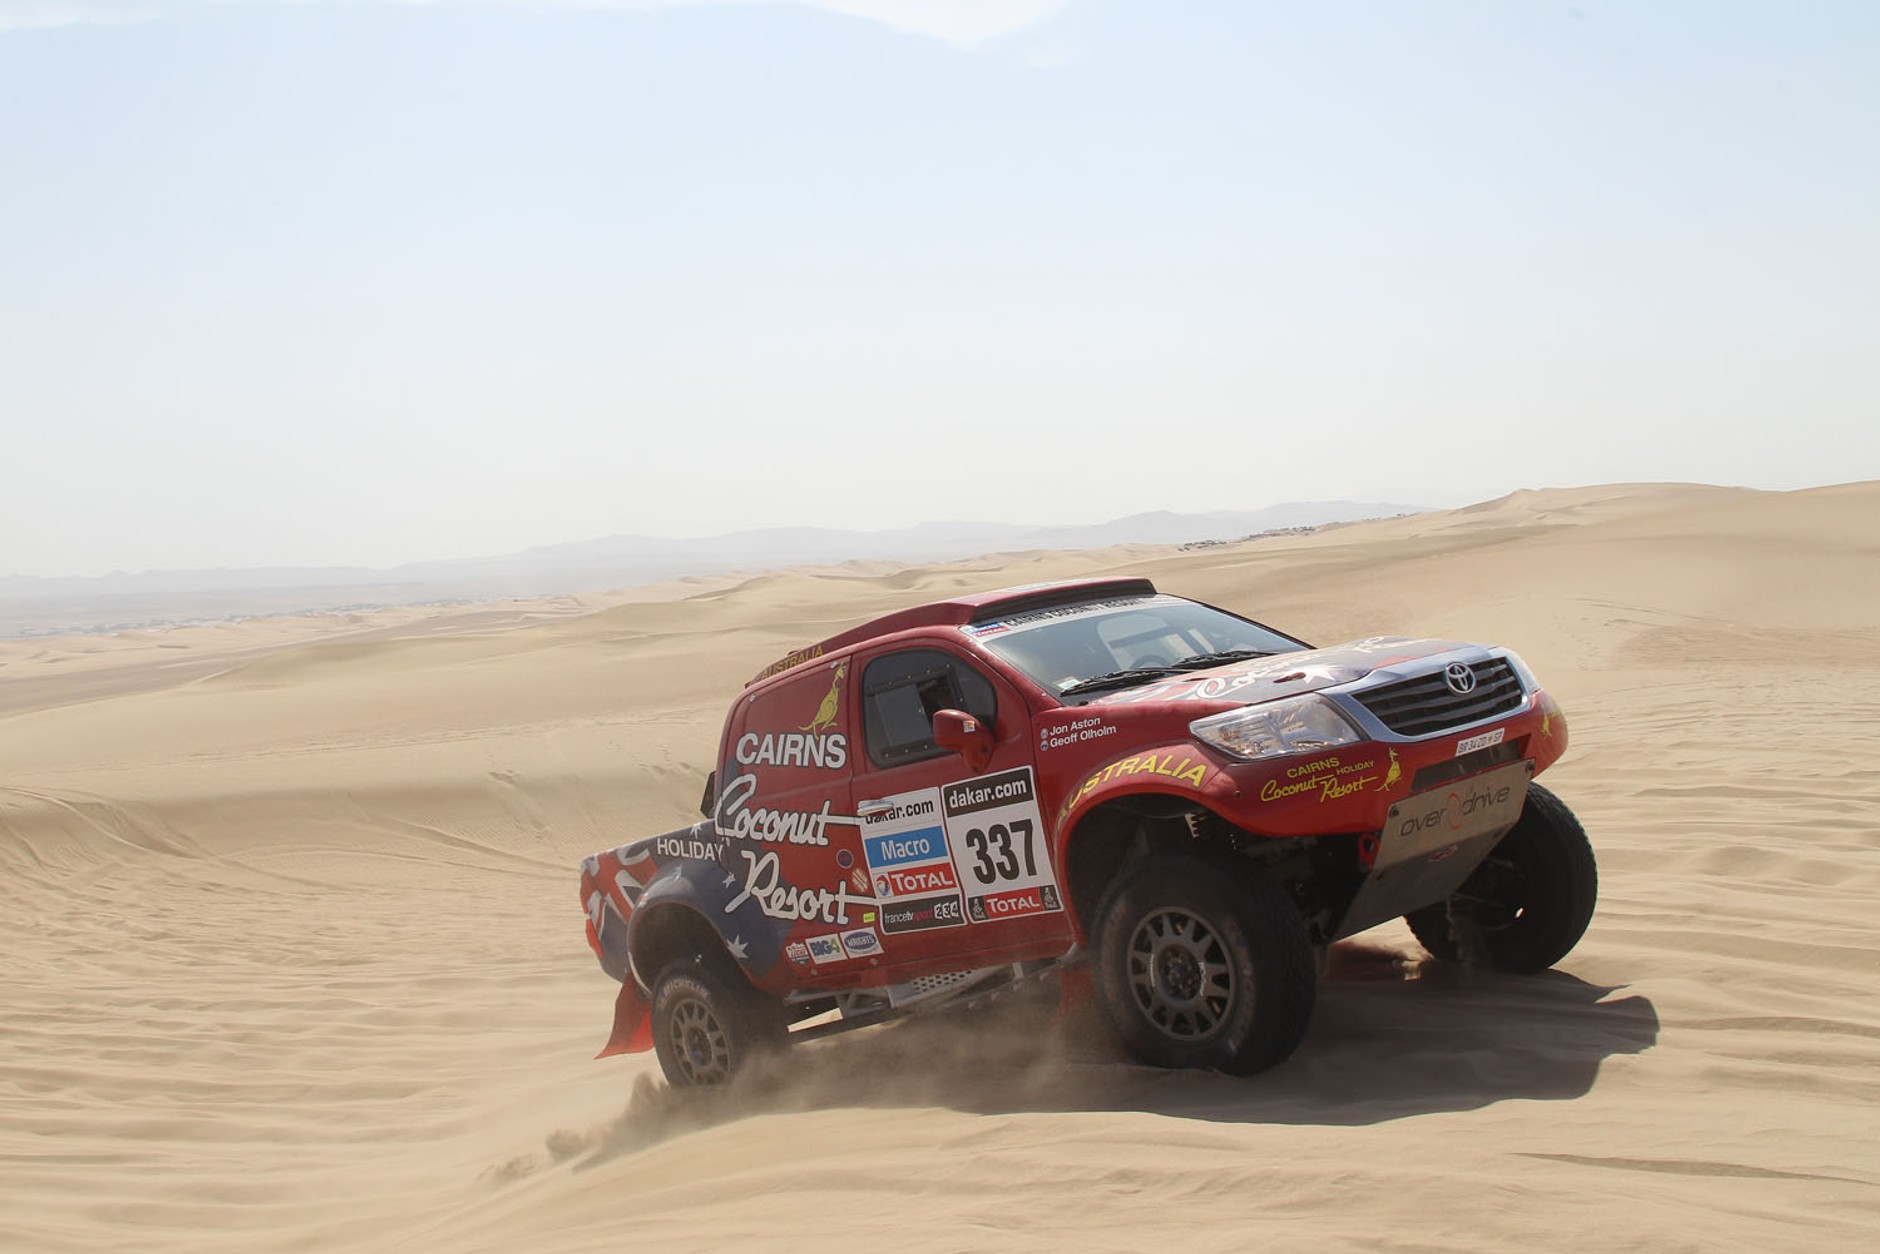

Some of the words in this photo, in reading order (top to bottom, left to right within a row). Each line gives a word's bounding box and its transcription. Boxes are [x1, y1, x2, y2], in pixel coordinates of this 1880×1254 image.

[1050, 725, 1068, 736] Jon
[1070, 717, 1101, 730] Aston
[1050, 733, 1078, 748] Geoff
[1080, 725, 1117, 741] Olholm
[736, 732, 847, 769] CAIRNS
[1286, 757, 1340, 778] CAIRNS
[1336, 760, 1374, 776] HOLIDAY
[949, 779, 1027, 809] dakar.com
[1261, 774, 1334, 801] Coconut
[1320, 775, 1379, 803] Resort
[714, 773, 866, 846] Coconut
[656, 837, 729, 862] HOLIDAY
[880, 837, 930, 861] Macro
[965, 818, 1038, 885] 337
[725, 850, 880, 925] Resort
[891, 871, 953, 892] TOTAL
[986, 895, 1041, 914] TOTAL
